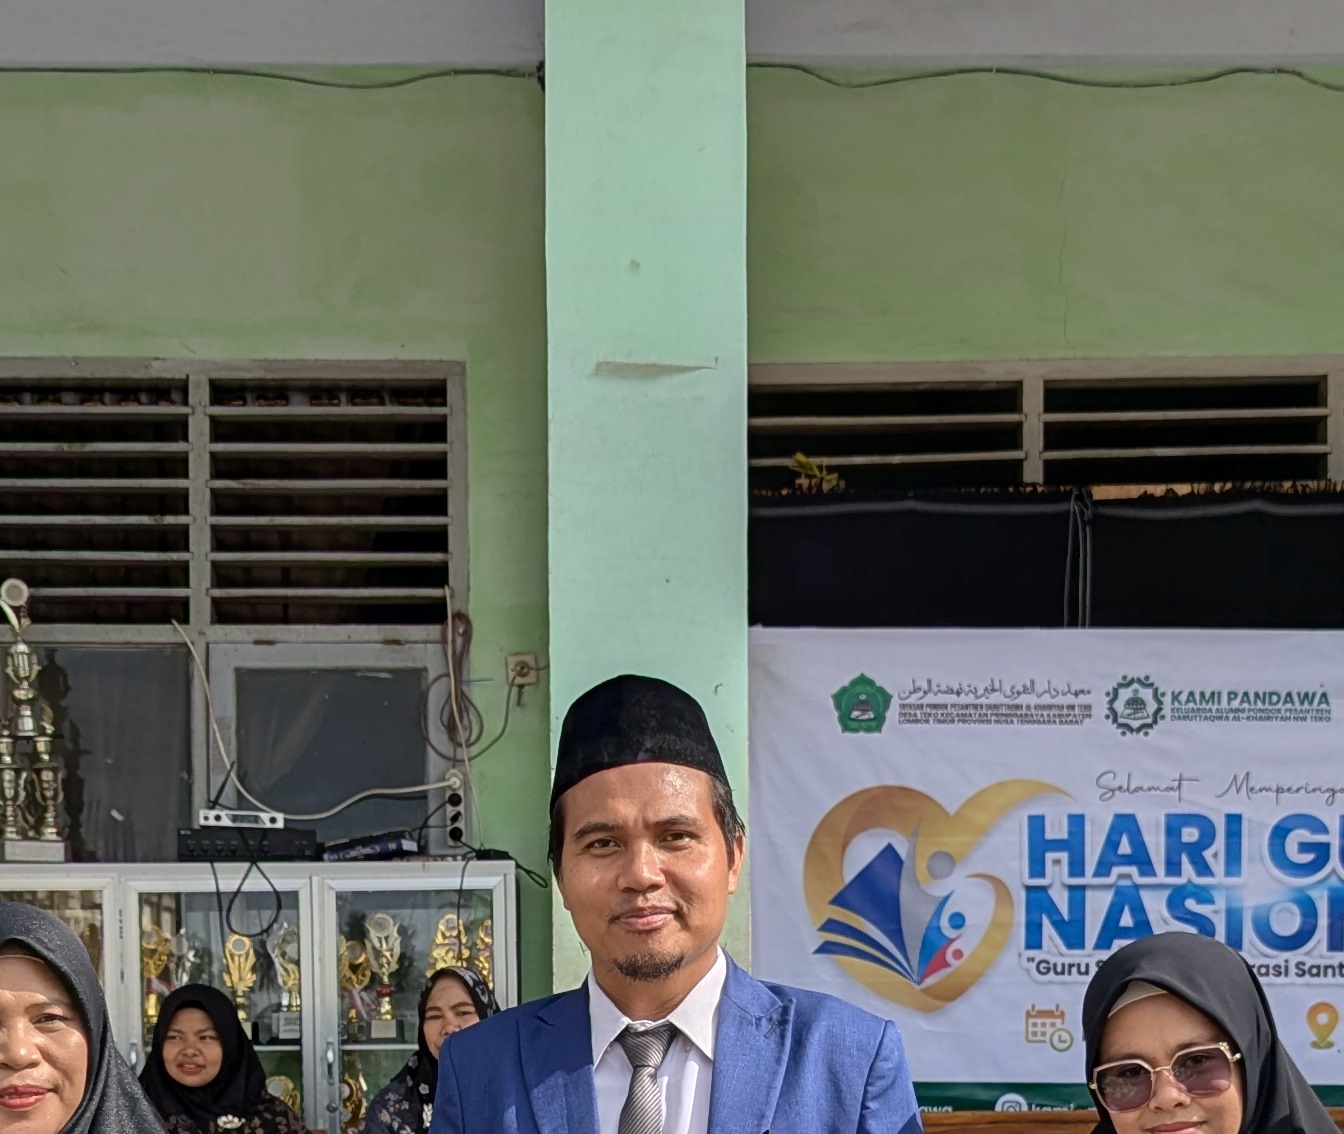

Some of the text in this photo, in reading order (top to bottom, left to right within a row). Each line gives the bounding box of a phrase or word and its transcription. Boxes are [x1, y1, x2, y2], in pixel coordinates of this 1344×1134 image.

[1170, 690, 1331, 707] KAMI PANDAWA
[1095, 771, 1199, 802] Selamat
[1026, 812, 1243, 879] HARI
[1027, 957, 1089, 976] "Guru
